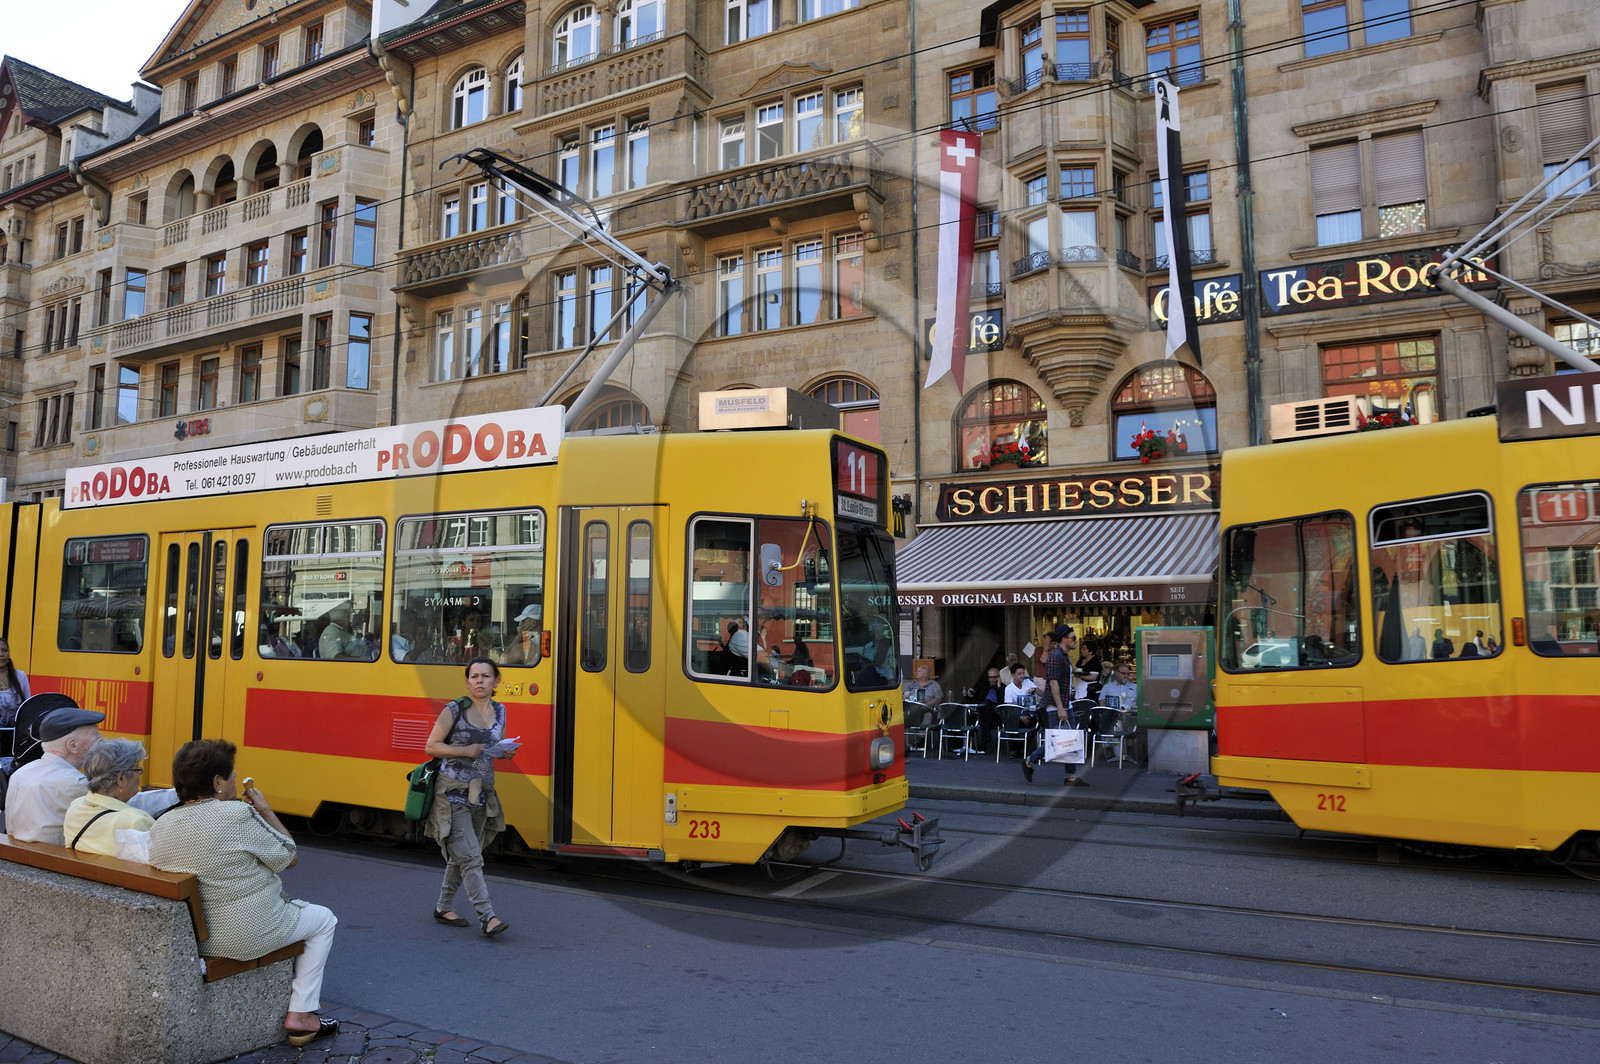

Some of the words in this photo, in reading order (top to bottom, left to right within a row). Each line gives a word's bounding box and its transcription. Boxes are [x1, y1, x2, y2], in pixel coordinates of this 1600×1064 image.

[1153, 281, 1239, 321] Cfé
[719, 397, 766, 406] MUSFELD
[188, 418, 211, 436] UBS
[173, 456, 228, 472] Professionelle
[230, 450, 285, 465] Hauswartung
[292, 438, 376, 458] Gebäudeunterhalt
[377, 423, 548, 471] PRODOBA
[276, 462, 357, 480] www.prodoba.ch
[848, 451, 866, 494] 11
[71, 467, 170, 503] PRODOBA
[186, 480, 198, 490] Tel.
[952, 473, 1213, 516] SCHIESSER
[1548, 492, 1577, 517] 11
[75, 544, 84, 560] 11
[868, 595, 934, 606] SCHESSER
[942, 594, 1006, 605] ORIGINAL
[1012, 592, 1064, 603] BASLER
[1072, 590, 1144, 602] LÄCKERLI
[1317, 793, 1346, 812] 212
[688, 820, 720, 839] 233
